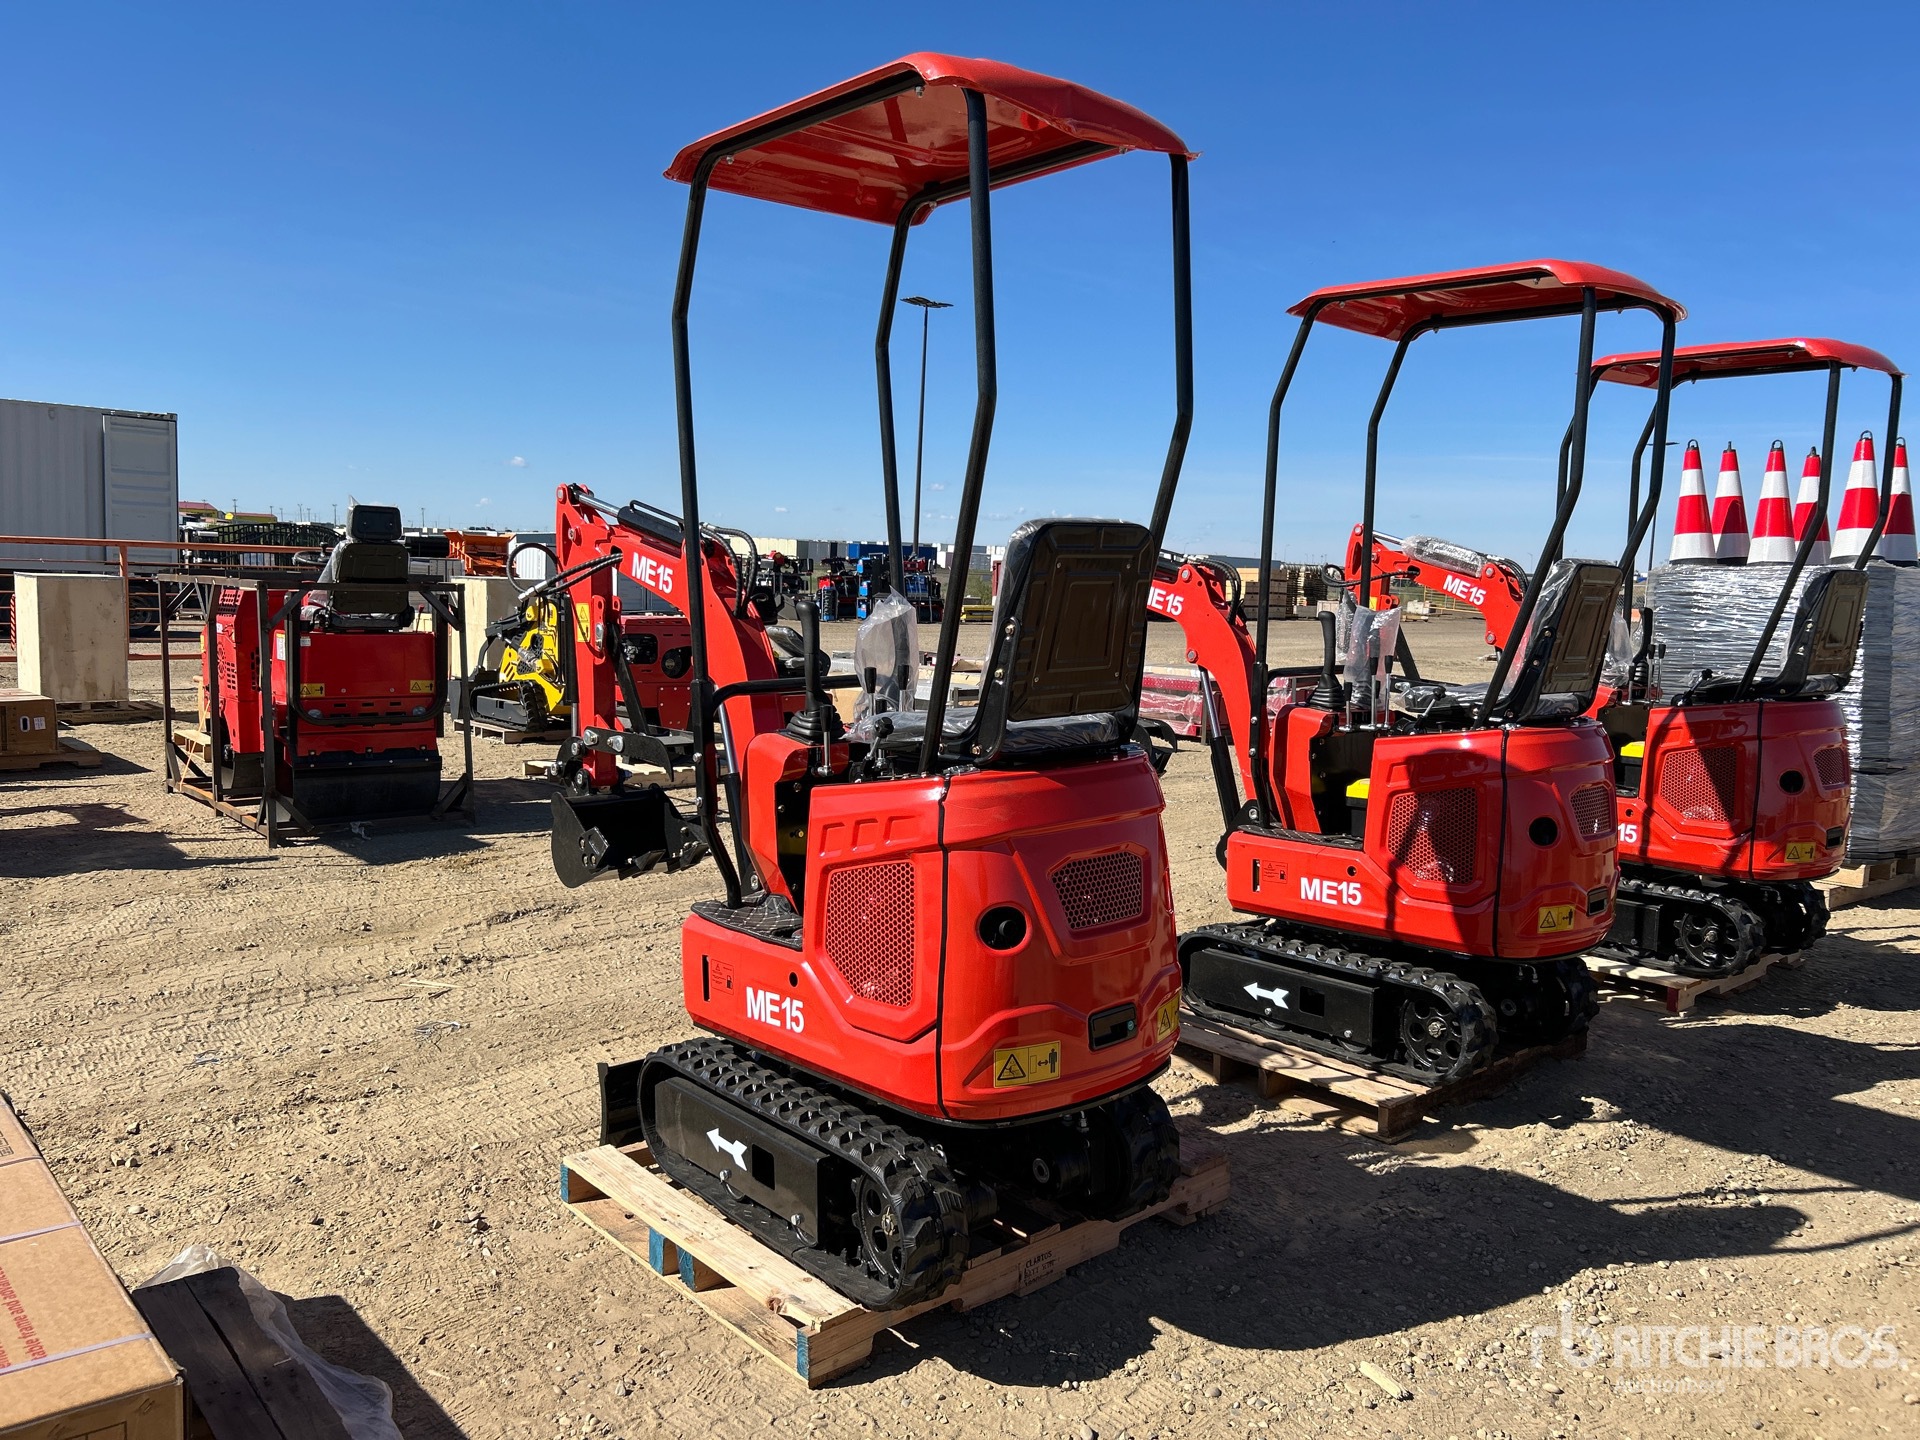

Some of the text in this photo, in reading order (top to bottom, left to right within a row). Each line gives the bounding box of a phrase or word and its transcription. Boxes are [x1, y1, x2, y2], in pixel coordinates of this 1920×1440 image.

[632, 552, 673, 594] ME15
[1443, 574, 1487, 605] ME15
[1618, 823, 1637, 843] 15
[1300, 877, 1362, 905] ME15
[746, 986, 805, 1033] ME15
[1, 1299, 25, 1316] and
[17, 1314, 37, 1340] frame
